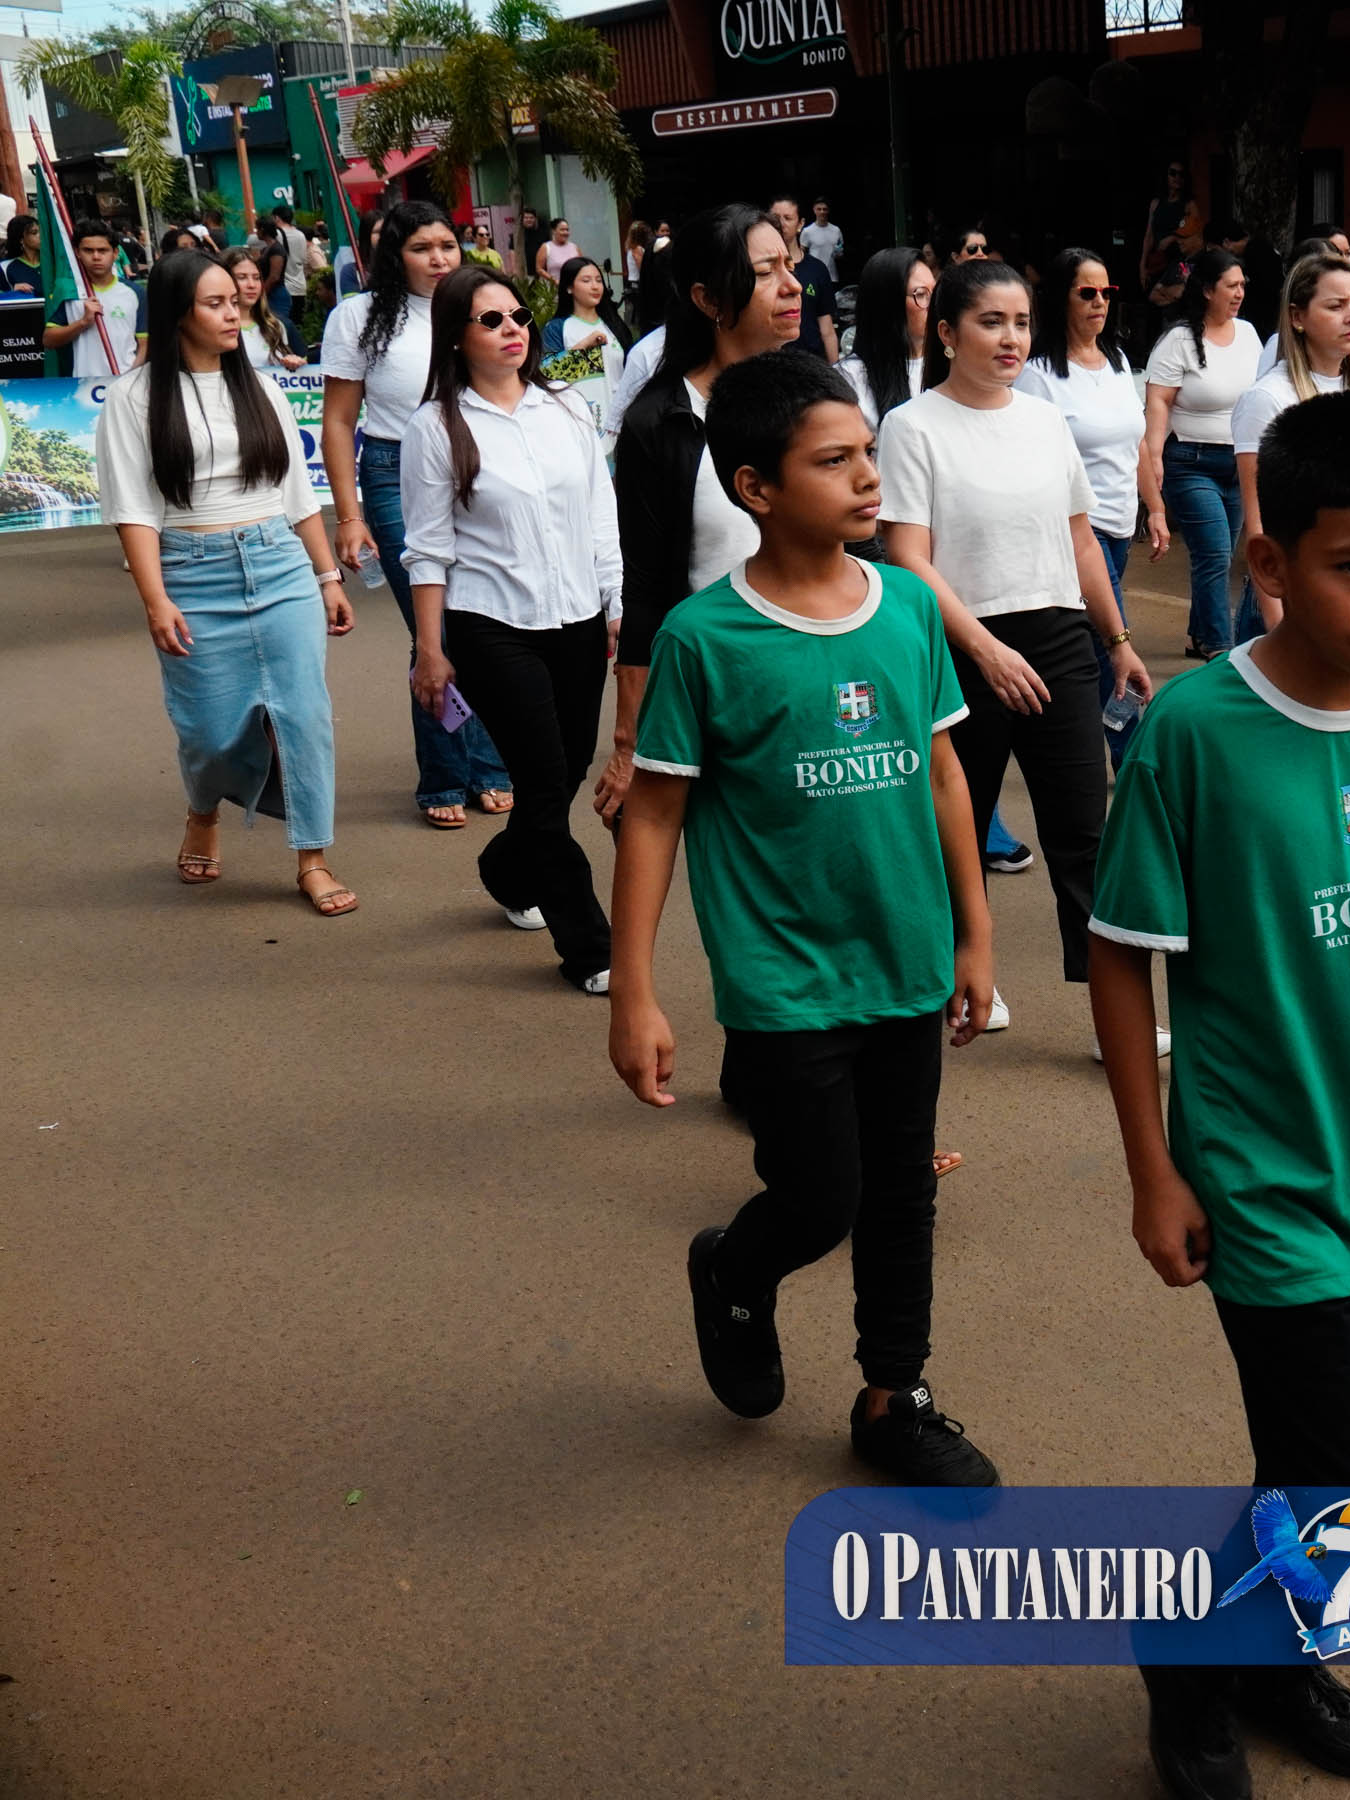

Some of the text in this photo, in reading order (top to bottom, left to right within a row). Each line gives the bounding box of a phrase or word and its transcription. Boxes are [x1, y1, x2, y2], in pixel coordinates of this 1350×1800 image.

[802, 46, 846, 66] BONITO
[676, 99, 806, 128] RESTAURANTE
[2, 337, 35, 347] SEJAM
[798, 740, 906, 760] PREFEITURA MUNICIPAL DE
[793, 749, 920, 788] BONITO
[806, 778, 908, 798] MATO GROSSO DO SUL
